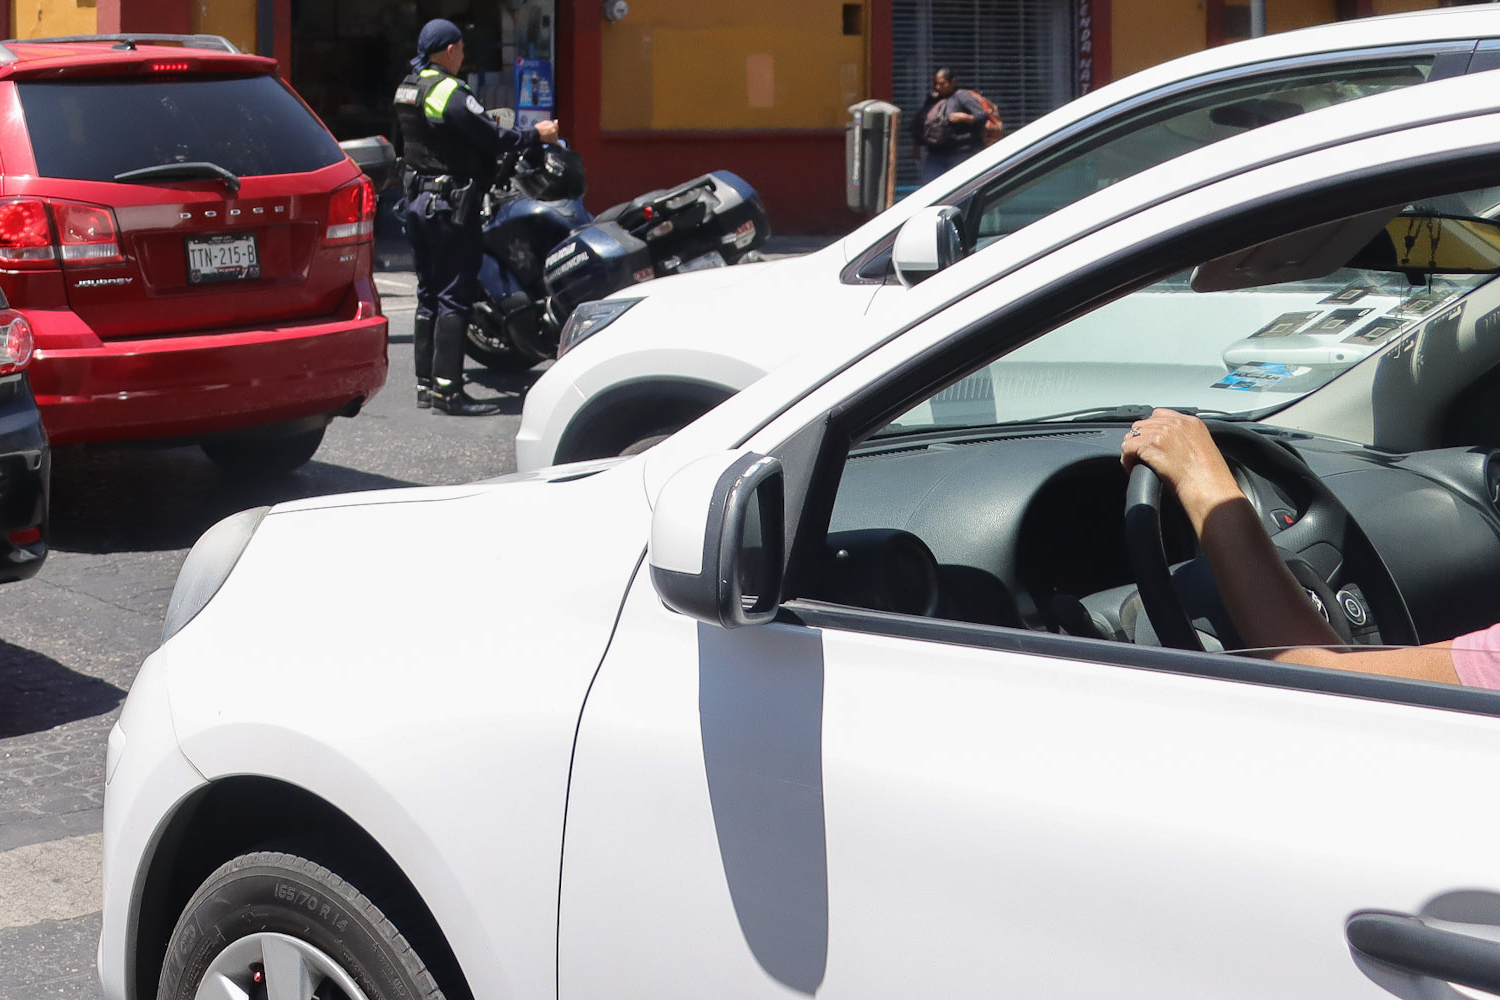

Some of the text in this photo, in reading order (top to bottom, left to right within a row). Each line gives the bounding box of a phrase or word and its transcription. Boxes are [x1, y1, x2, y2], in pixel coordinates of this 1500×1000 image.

[180, 206, 284, 219] DODGE
[190, 244, 255, 268] TTN-215-B
[274, 882, 349, 933] 165/70 R 14
